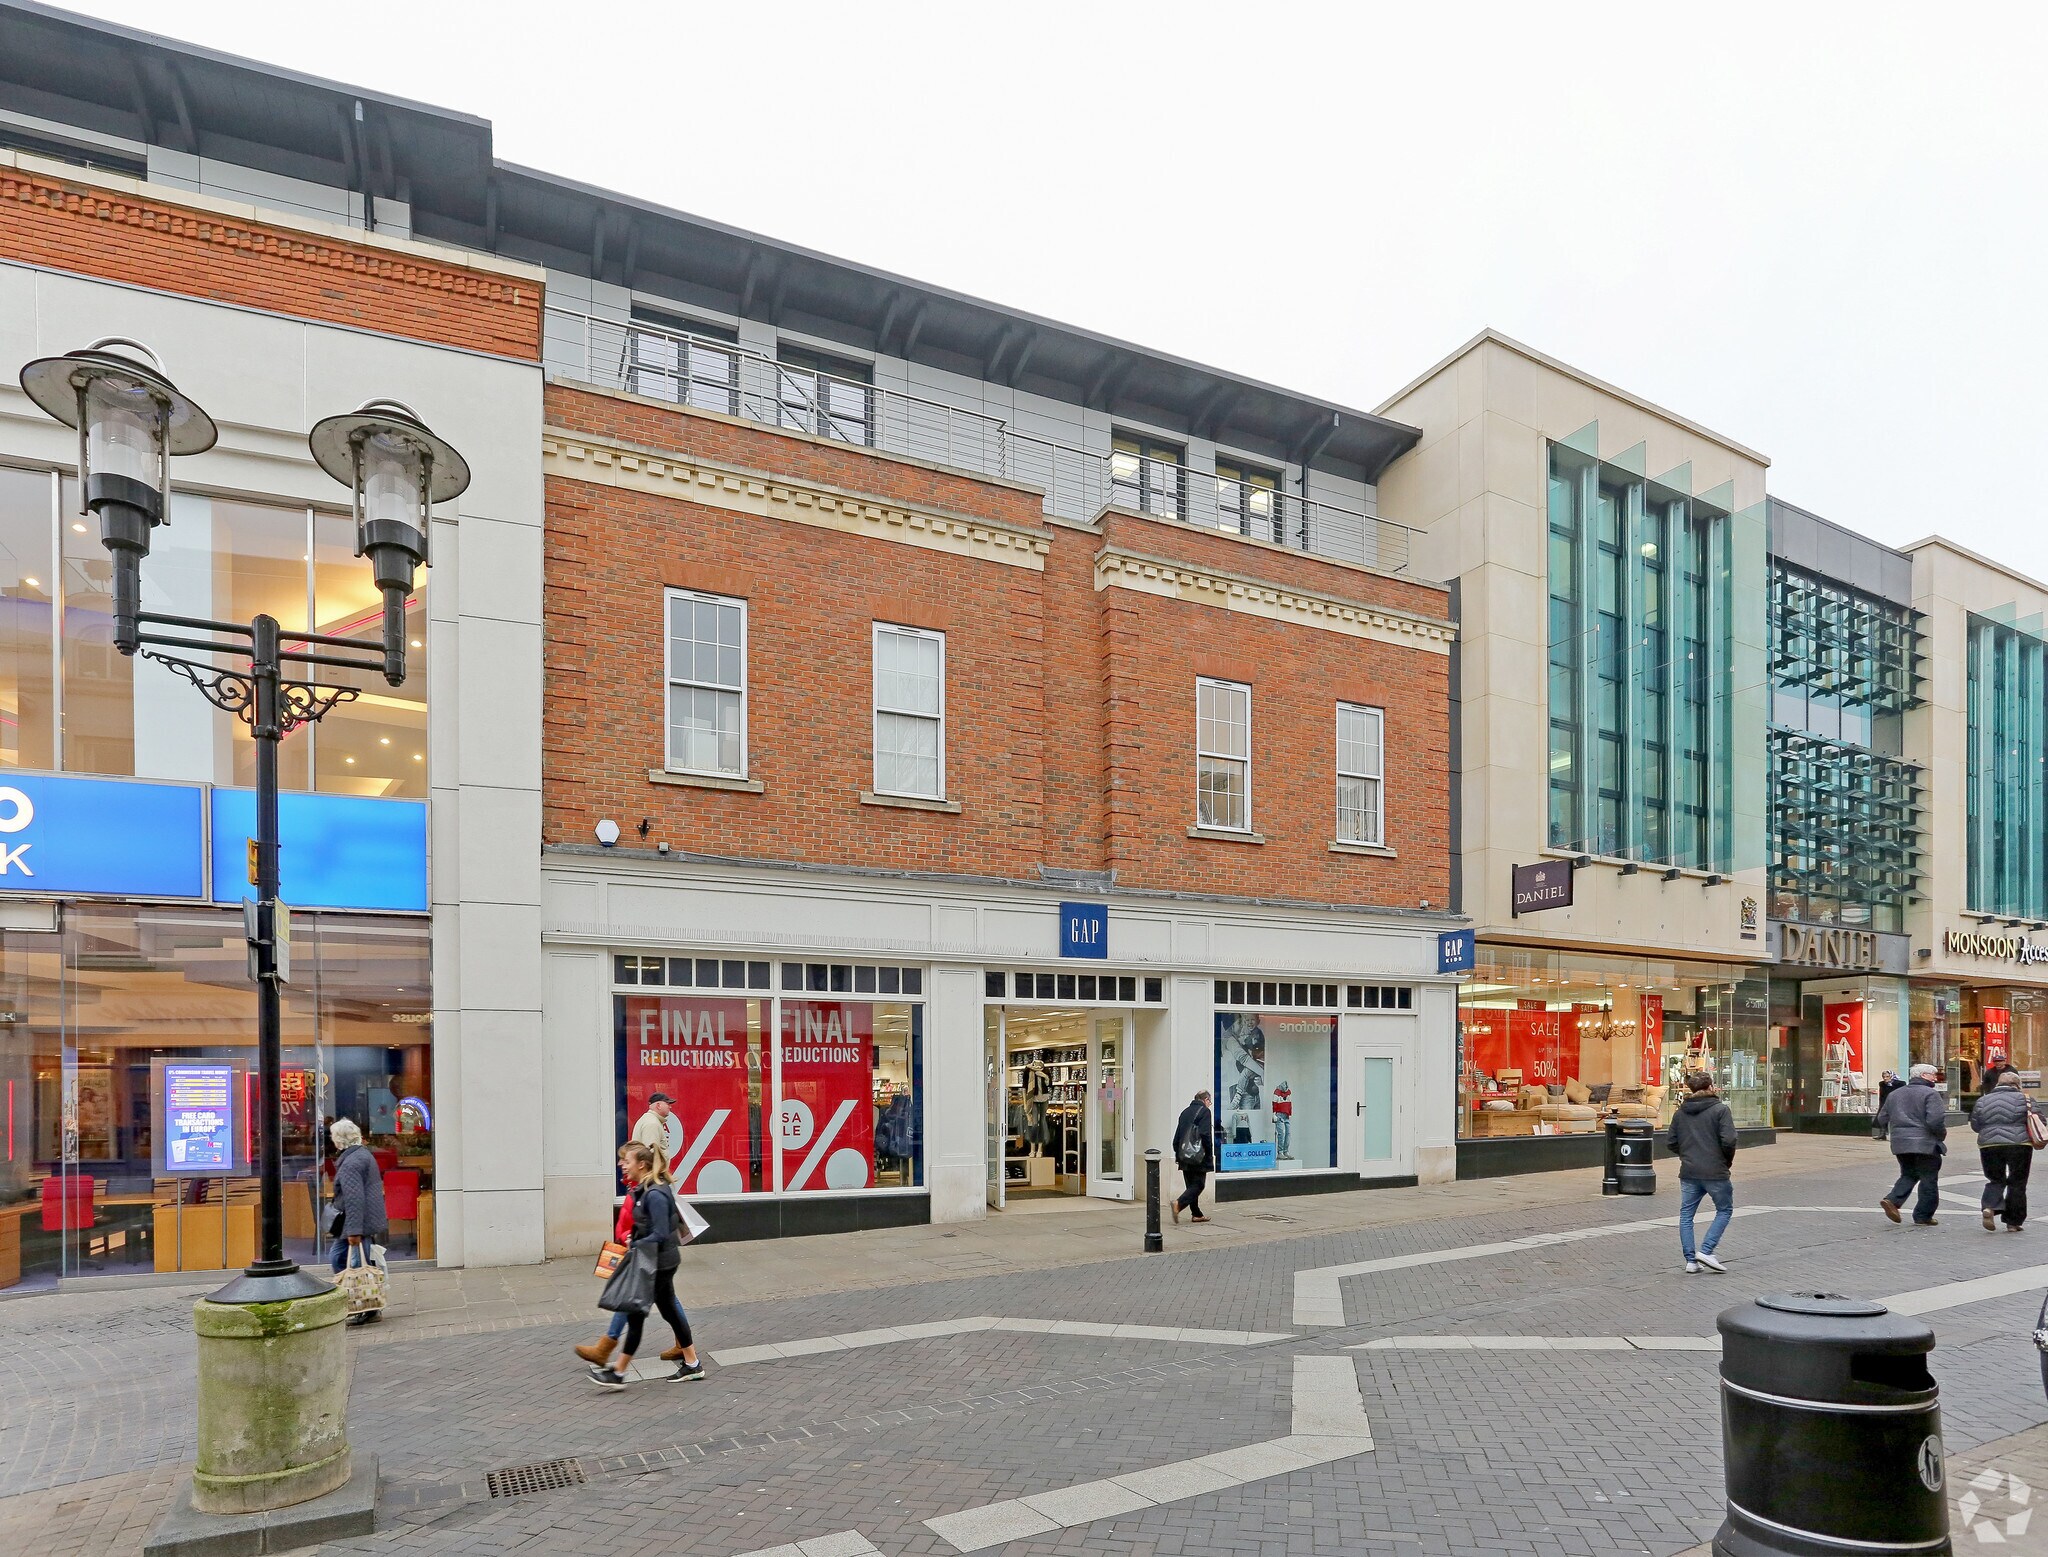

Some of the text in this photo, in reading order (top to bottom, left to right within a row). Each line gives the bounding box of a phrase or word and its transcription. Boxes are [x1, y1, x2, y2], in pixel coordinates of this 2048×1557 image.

[1516, 886, 1565, 904] DANIEL
[1071, 917, 1099, 944] GAP
[1445, 938, 1463, 957] GAP
[1781, 923, 1885, 970] DANIEL
[1947, 930, 2016, 960] MONSOON
[1445, 956, 1463, 964] KIDS
[1522, 1001, 1537, 1010] SALE
[1580, 1004, 1593, 1012] SALE
[640, 1009, 733, 1046] FINAL
[1531, 1022, 1559, 1036] SALE
[1987, 1022, 2007, 1034] SALE
[1643, 1007, 1656, 1081] SAL
[640, 1049, 734, 1067] REDUCTIONS
[1533, 1060, 1557, 1078] 50%
[174, 1118, 224, 1126] TRANSACTIONS
[197, 1111, 216, 1119] CARD
[191, 1125, 216, 1133] EUROPE
[782, 1126, 801, 1136] LE
